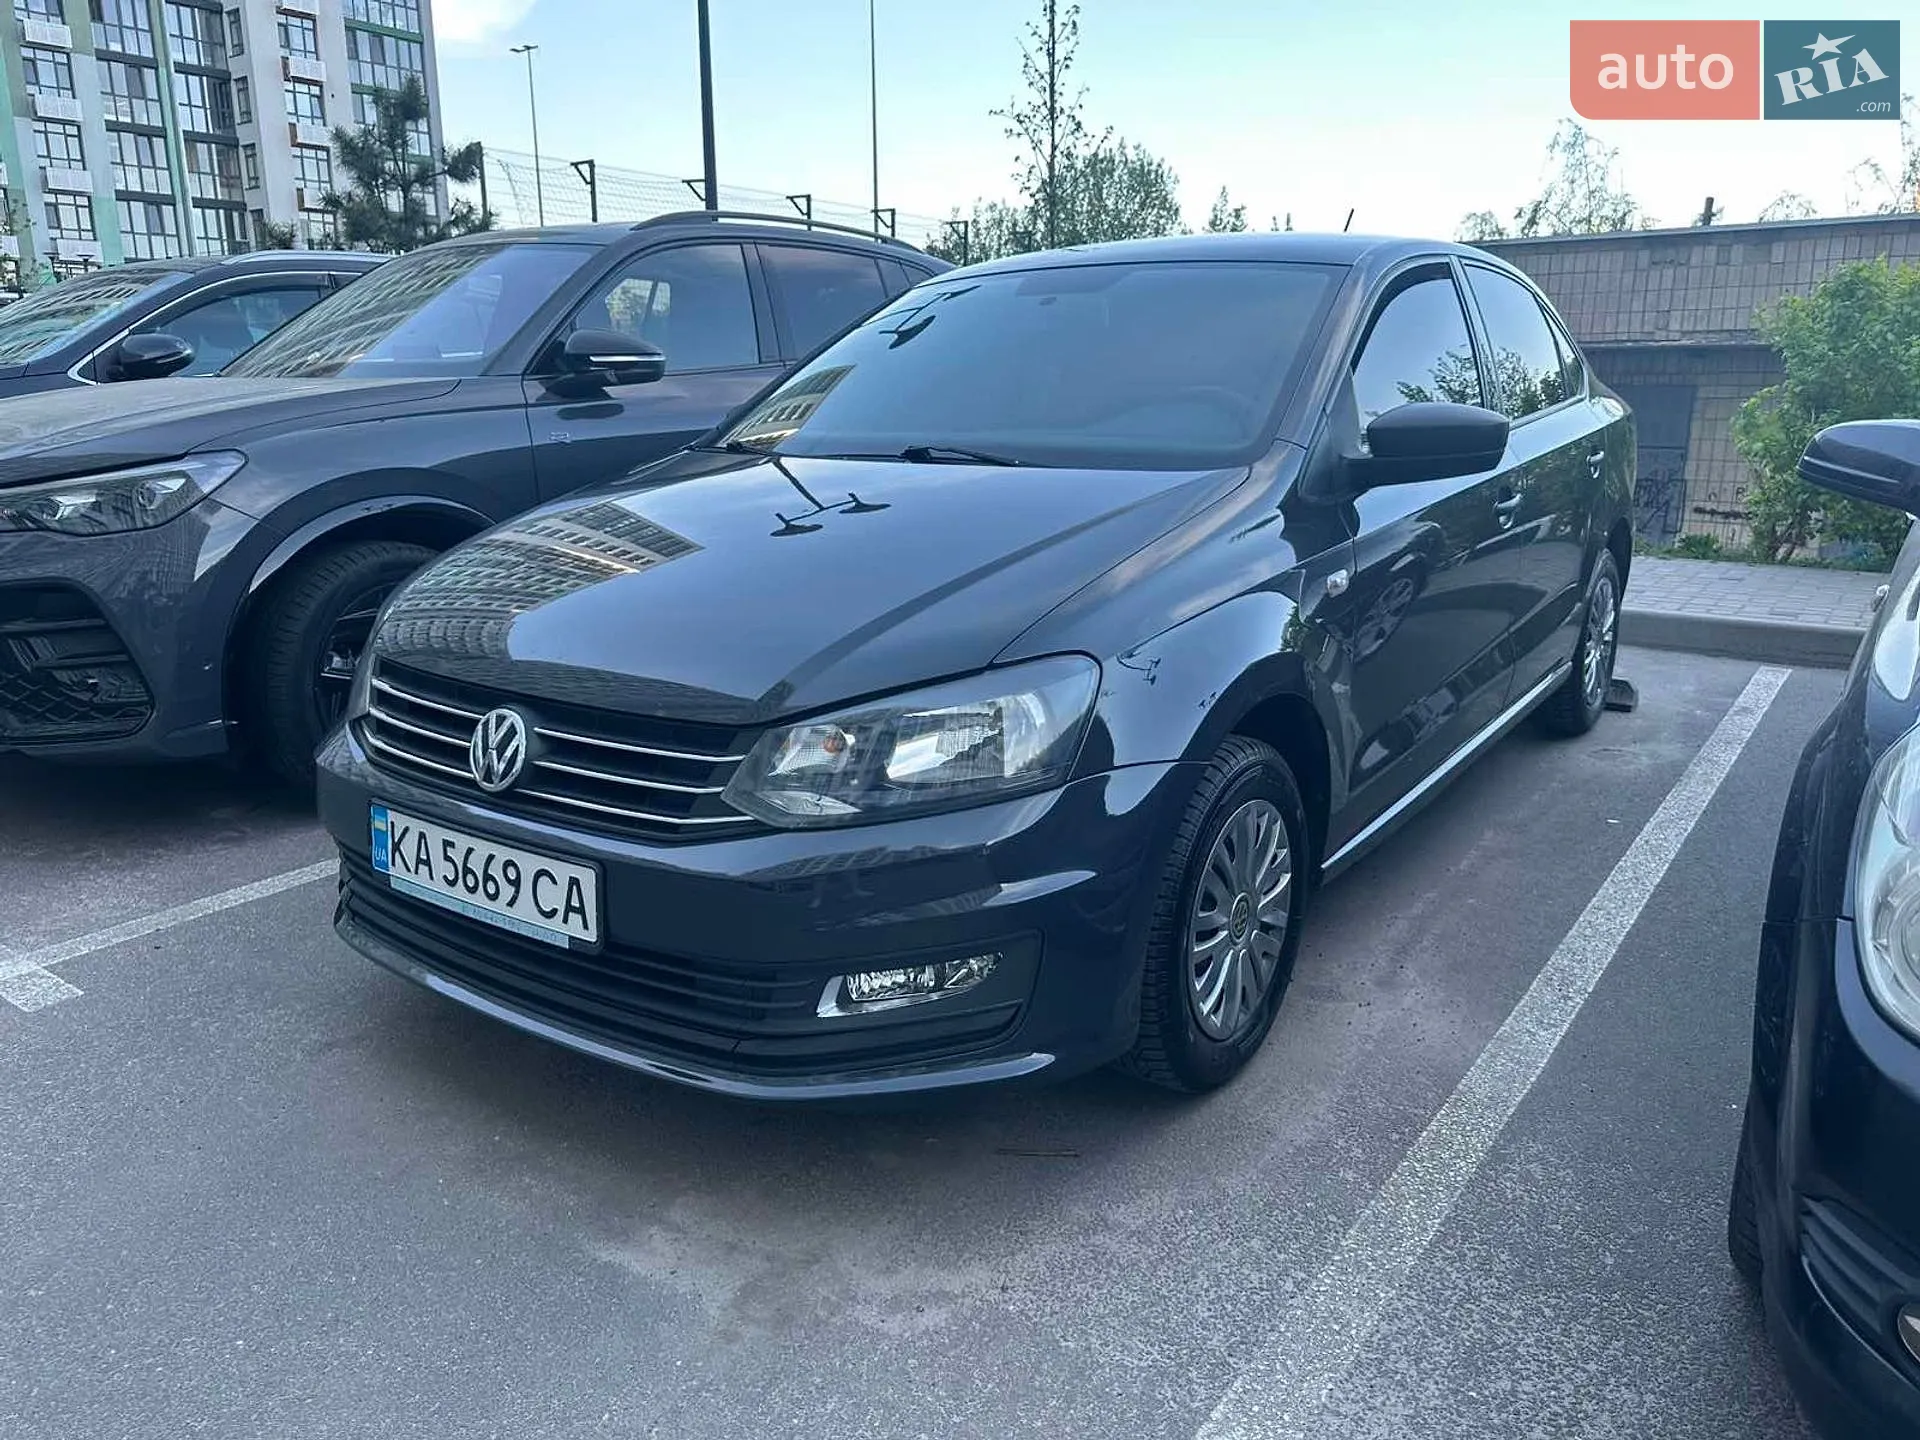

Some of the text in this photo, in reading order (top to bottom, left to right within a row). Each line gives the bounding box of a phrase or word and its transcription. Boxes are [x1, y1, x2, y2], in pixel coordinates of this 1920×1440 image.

[375, 846, 387, 862] UA
[390, 821, 435, 881] KA
[441, 838, 522, 908] 5669
[532, 868, 589, 931] CA
